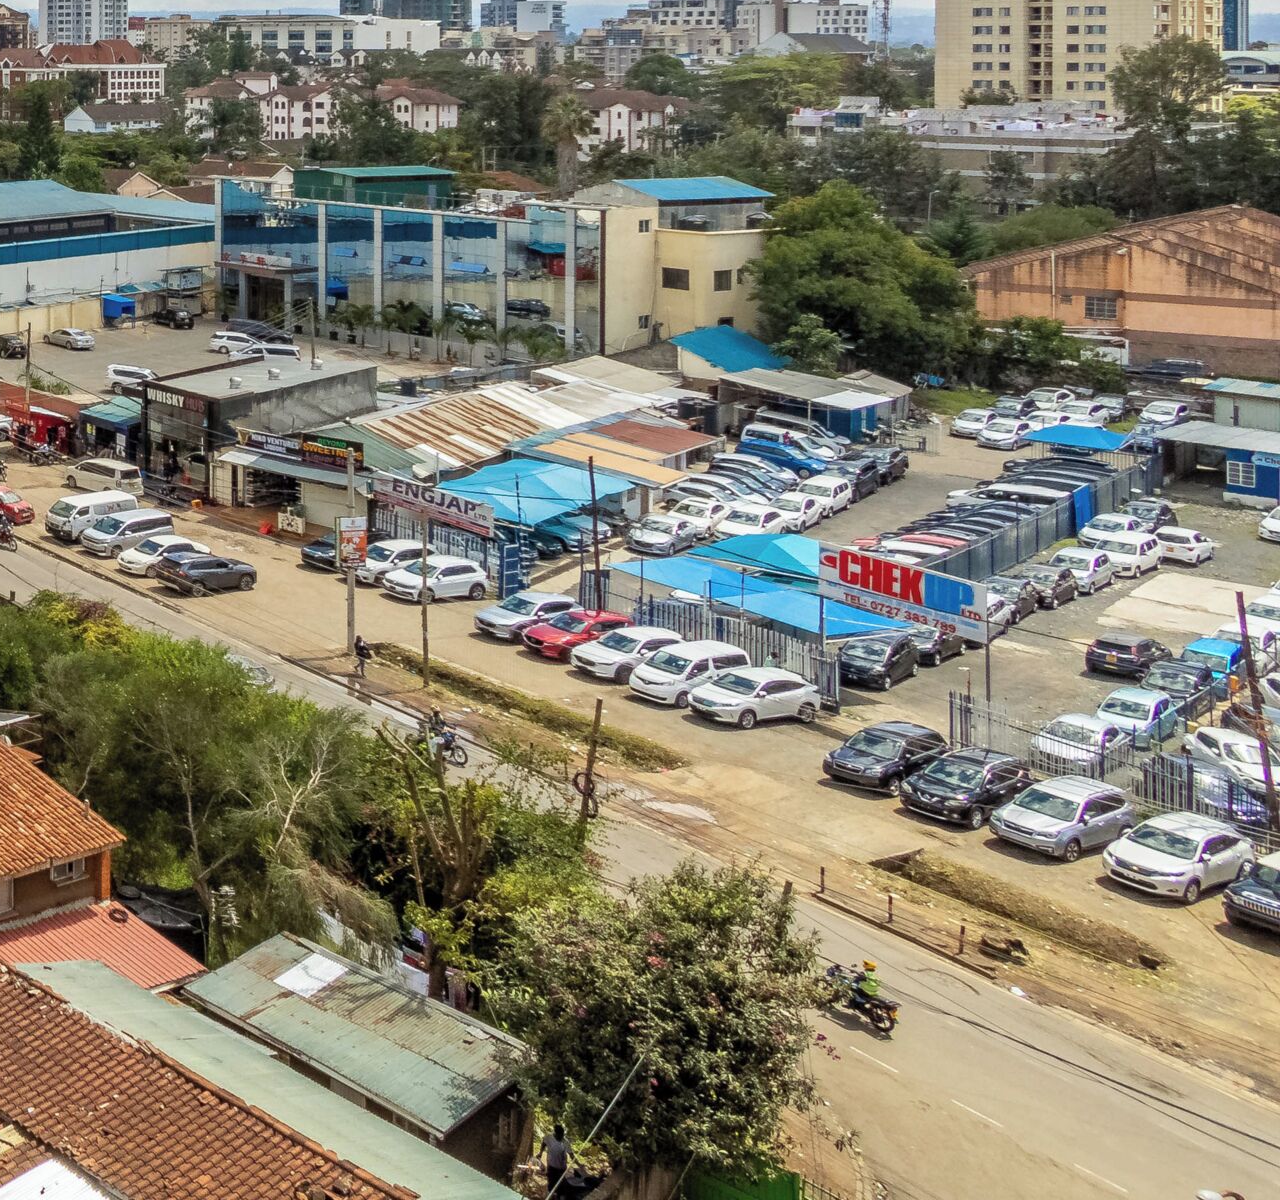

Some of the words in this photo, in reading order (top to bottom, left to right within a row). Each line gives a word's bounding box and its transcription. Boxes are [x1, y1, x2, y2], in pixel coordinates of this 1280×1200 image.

[147, 387, 184, 407] WHISKY
[185, 396, 205, 412] HUB
[267, 437, 300, 449] VENTURES
[303, 442, 364, 460] SWEETNES
[318, 438, 347, 448] BEYOND
[392, 478, 477, 515] ENGJAP
[870, 600, 901, 619] 0727
[904, 610, 929, 626] 383
[932, 618, 957, 634] 789
[960, 608, 982, 621] LTD
